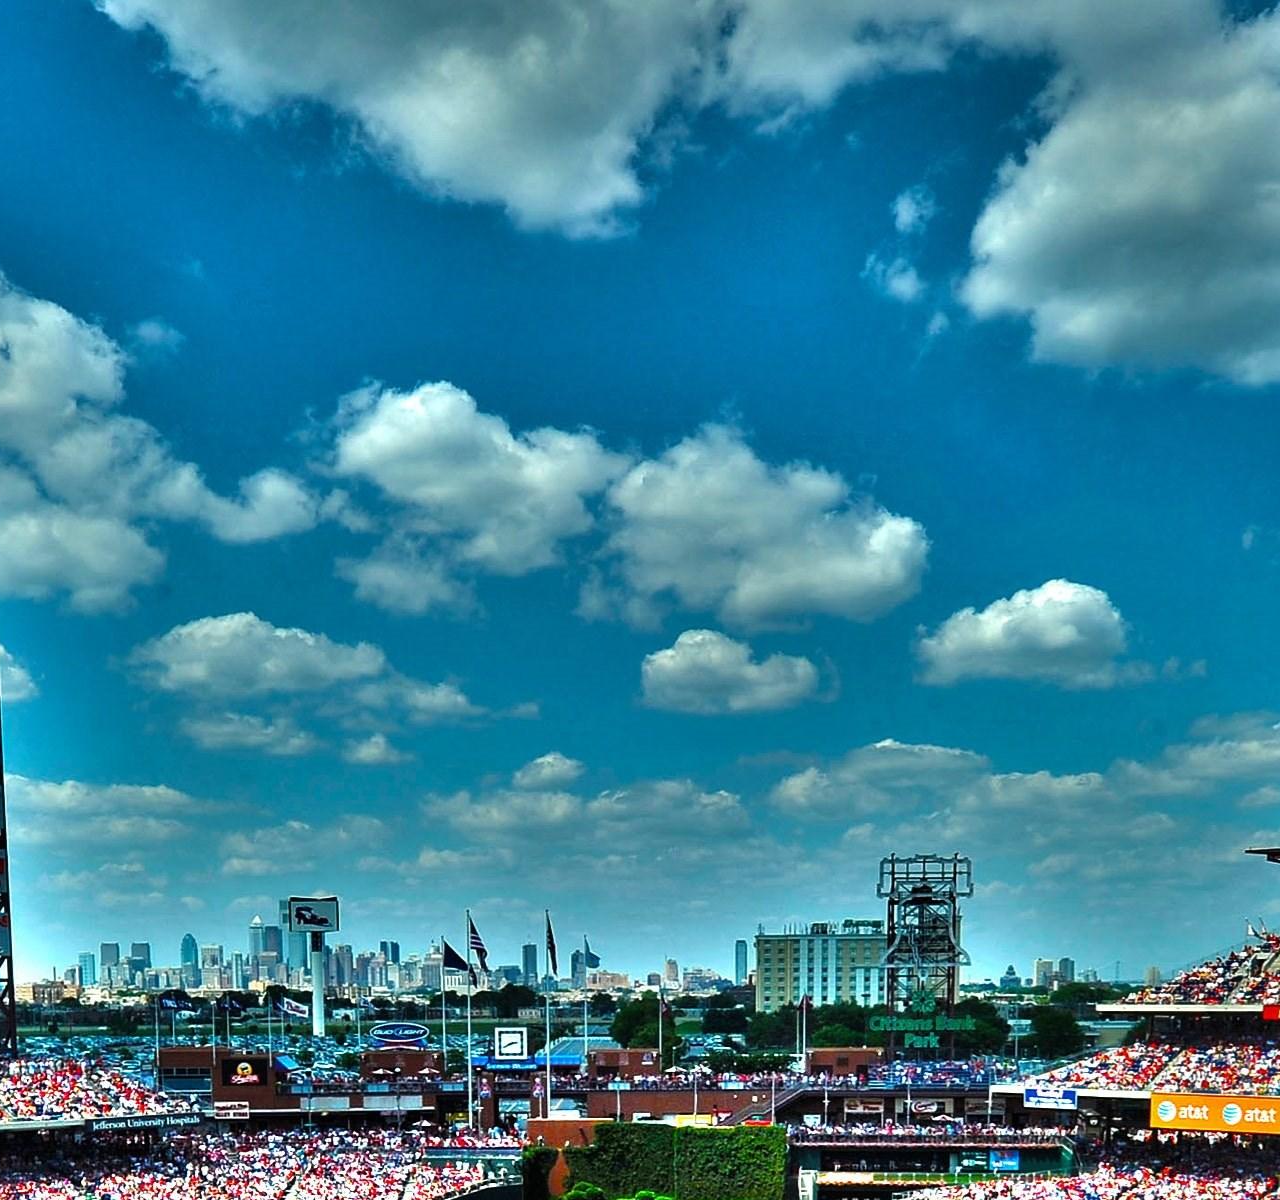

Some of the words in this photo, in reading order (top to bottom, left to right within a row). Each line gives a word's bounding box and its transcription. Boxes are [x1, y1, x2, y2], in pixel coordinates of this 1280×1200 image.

[870, 1016, 933, 1031] Citizens
[935, 1015, 977, 1031] Bank
[399, 1028, 426, 1036] LIGHT
[904, 1032, 940, 1048] Park
[91, 1118, 124, 1130] Jefferson
[126, 1115, 165, 1128] University
[166, 1112, 200, 1126] Hospitals
[1178, 1105, 1209, 1121] at&t
[1244, 1107, 1276, 1123] at&t
